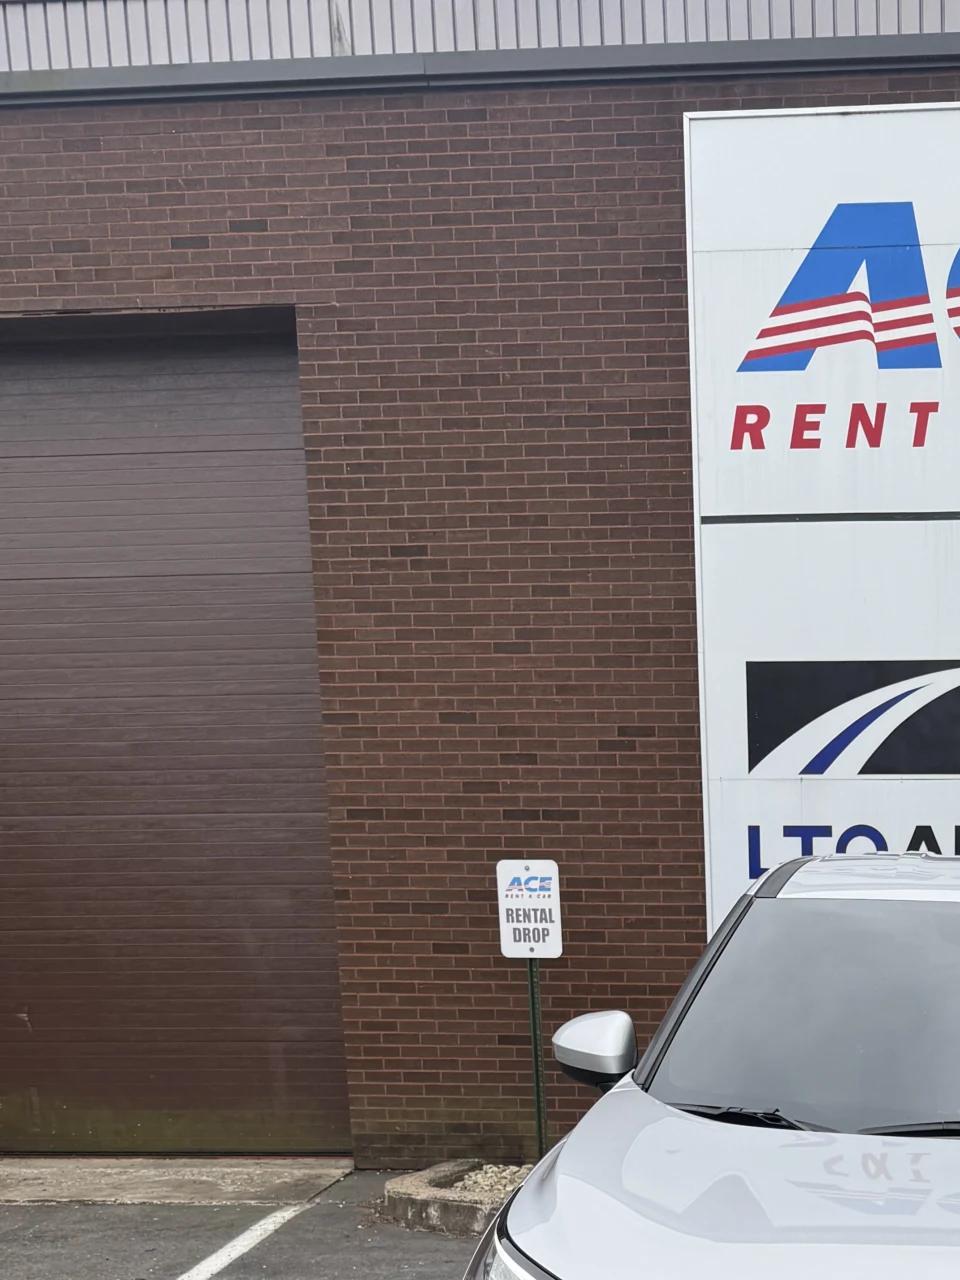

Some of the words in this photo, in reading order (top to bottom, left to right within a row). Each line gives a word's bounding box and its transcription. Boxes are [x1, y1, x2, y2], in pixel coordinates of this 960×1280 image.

[729, 401, 940, 451] RENT
[505, 876, 553, 892] ACE
[505, 908, 555, 924] RENTAL
[512, 927, 550, 943] DROP
